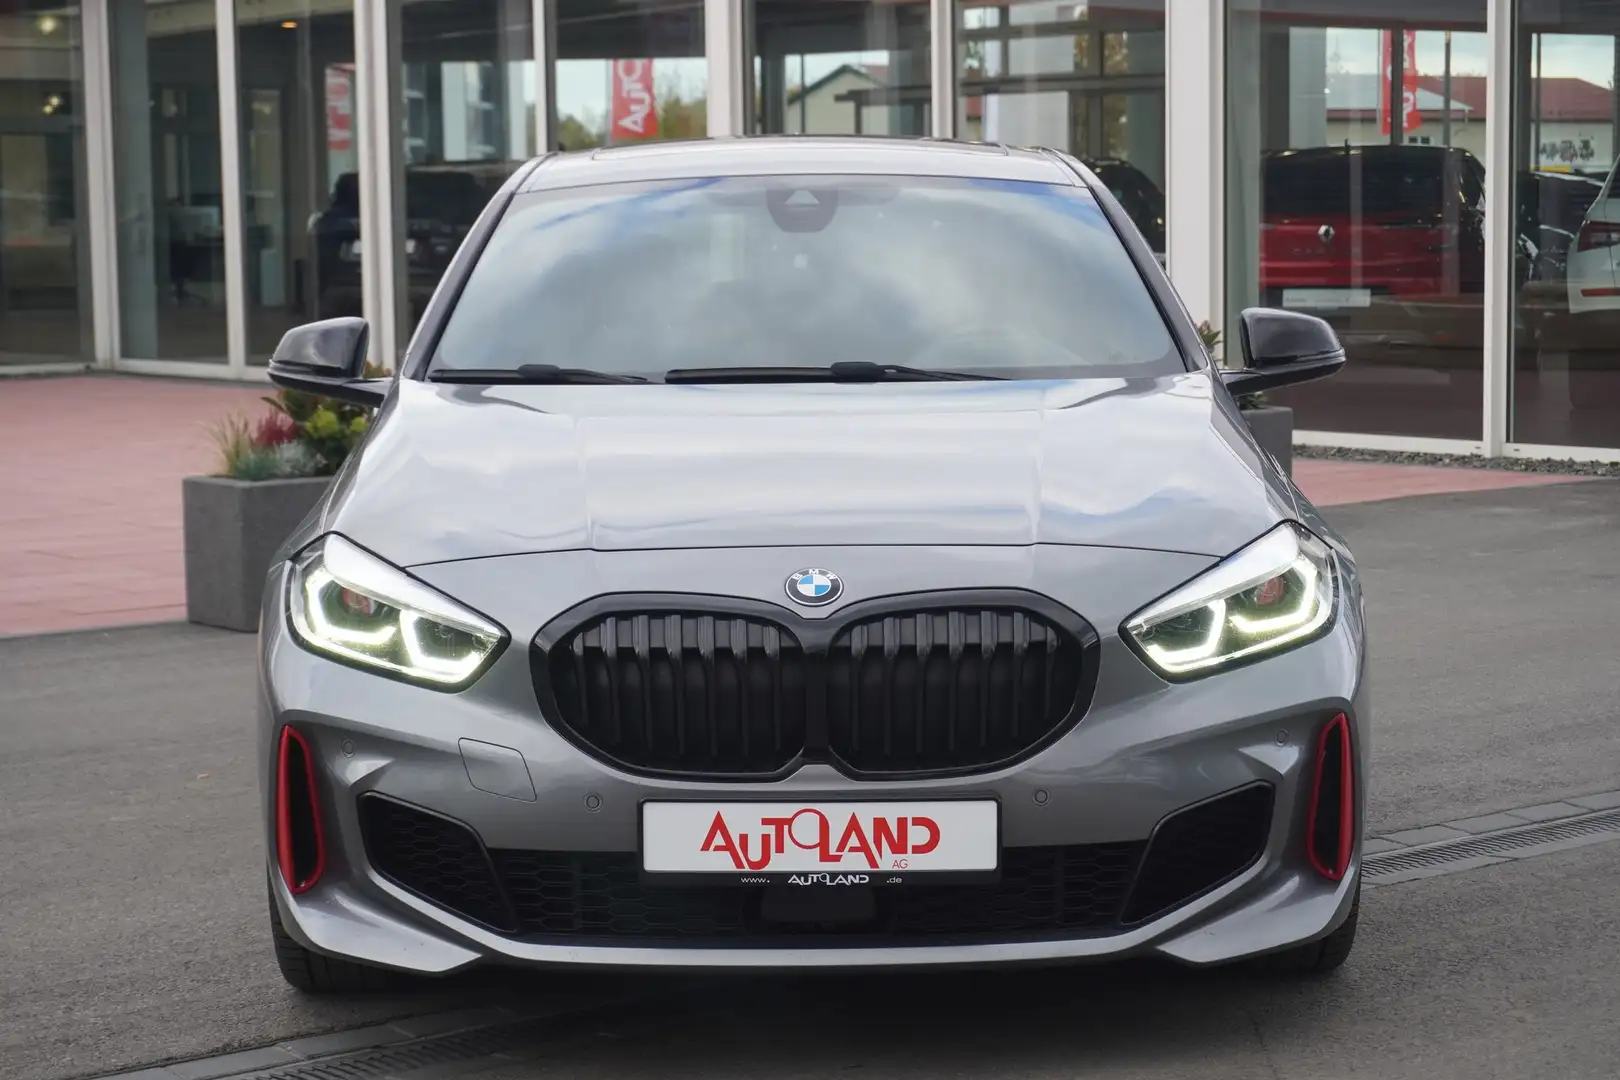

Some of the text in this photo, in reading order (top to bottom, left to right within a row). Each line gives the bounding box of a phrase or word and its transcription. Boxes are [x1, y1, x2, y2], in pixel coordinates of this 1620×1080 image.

[791, 569, 837, 580] BMW
[700, 808, 941, 871] AUTOLAND
[891, 859, 909, 869] AG
